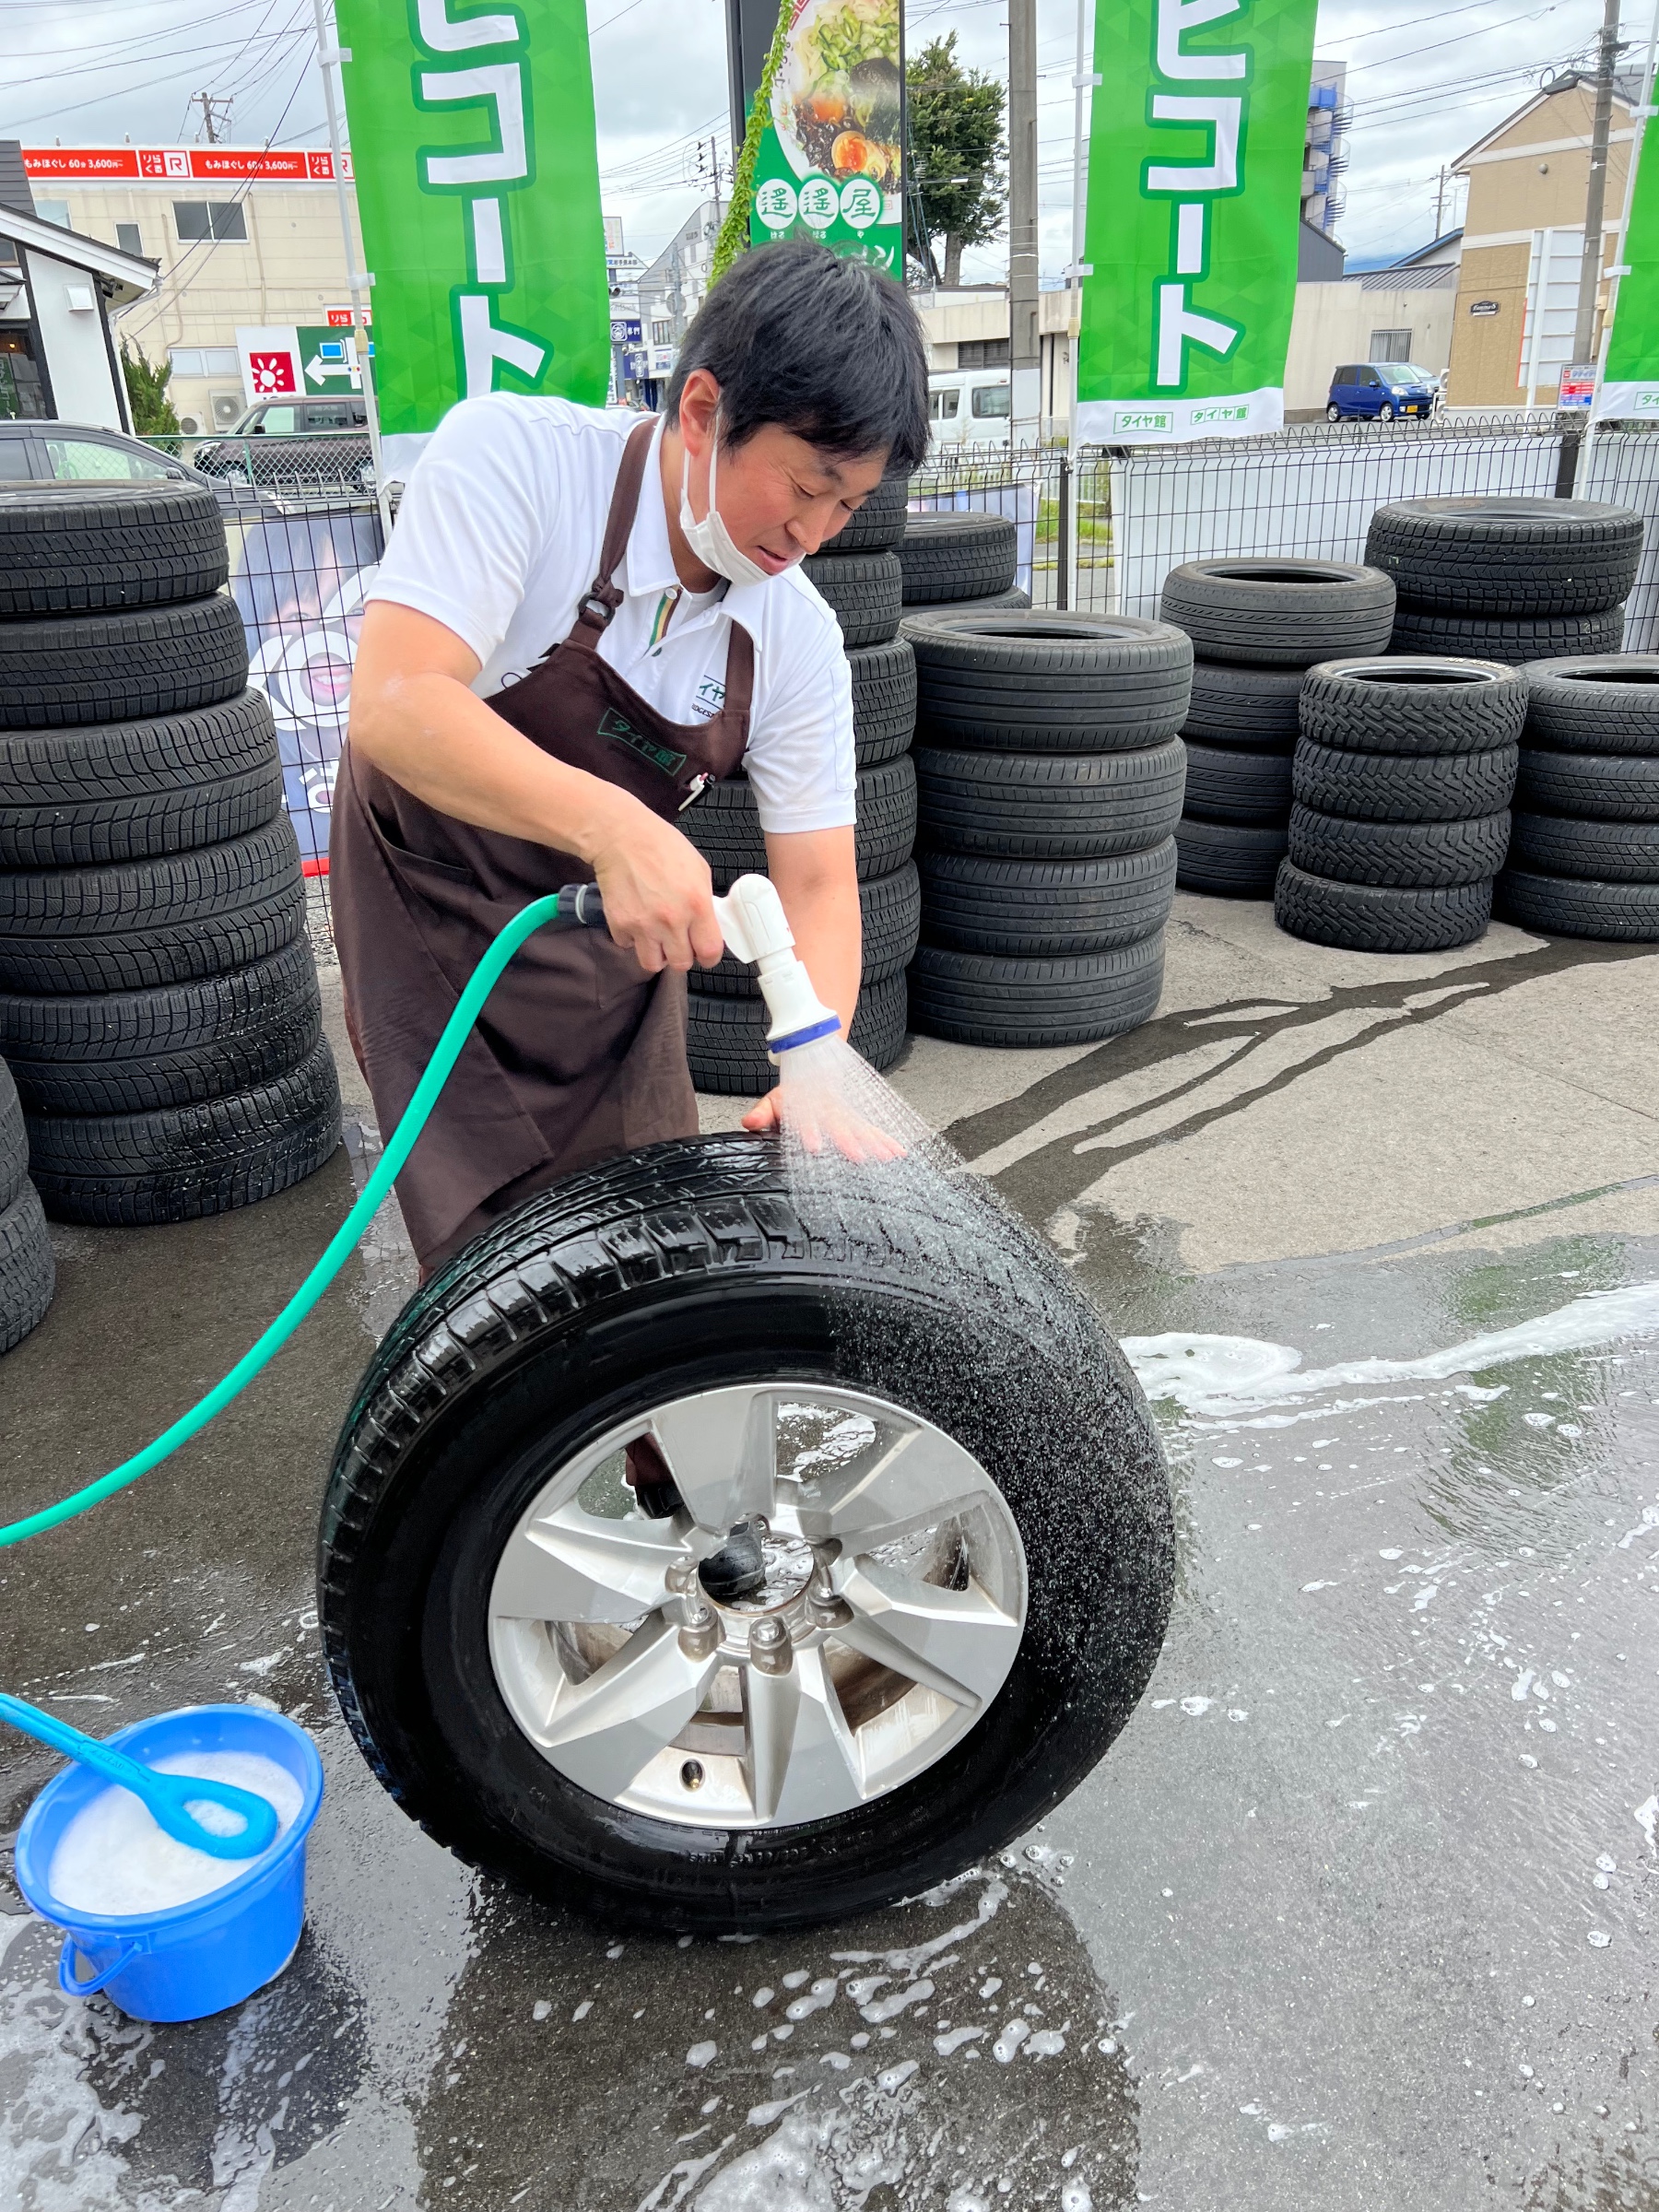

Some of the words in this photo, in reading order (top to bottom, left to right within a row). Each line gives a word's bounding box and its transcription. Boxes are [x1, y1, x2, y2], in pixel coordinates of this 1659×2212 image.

[25, 159, 65, 169] もみほぐし
[68, 159, 86, 169] 60分
[170, 158, 182, 171] R
[206, 159, 244, 170] もみほぐし
[1194, 406, 1247, 423] タイヤ館
[1122, 415, 1167, 429] タイヤ館
